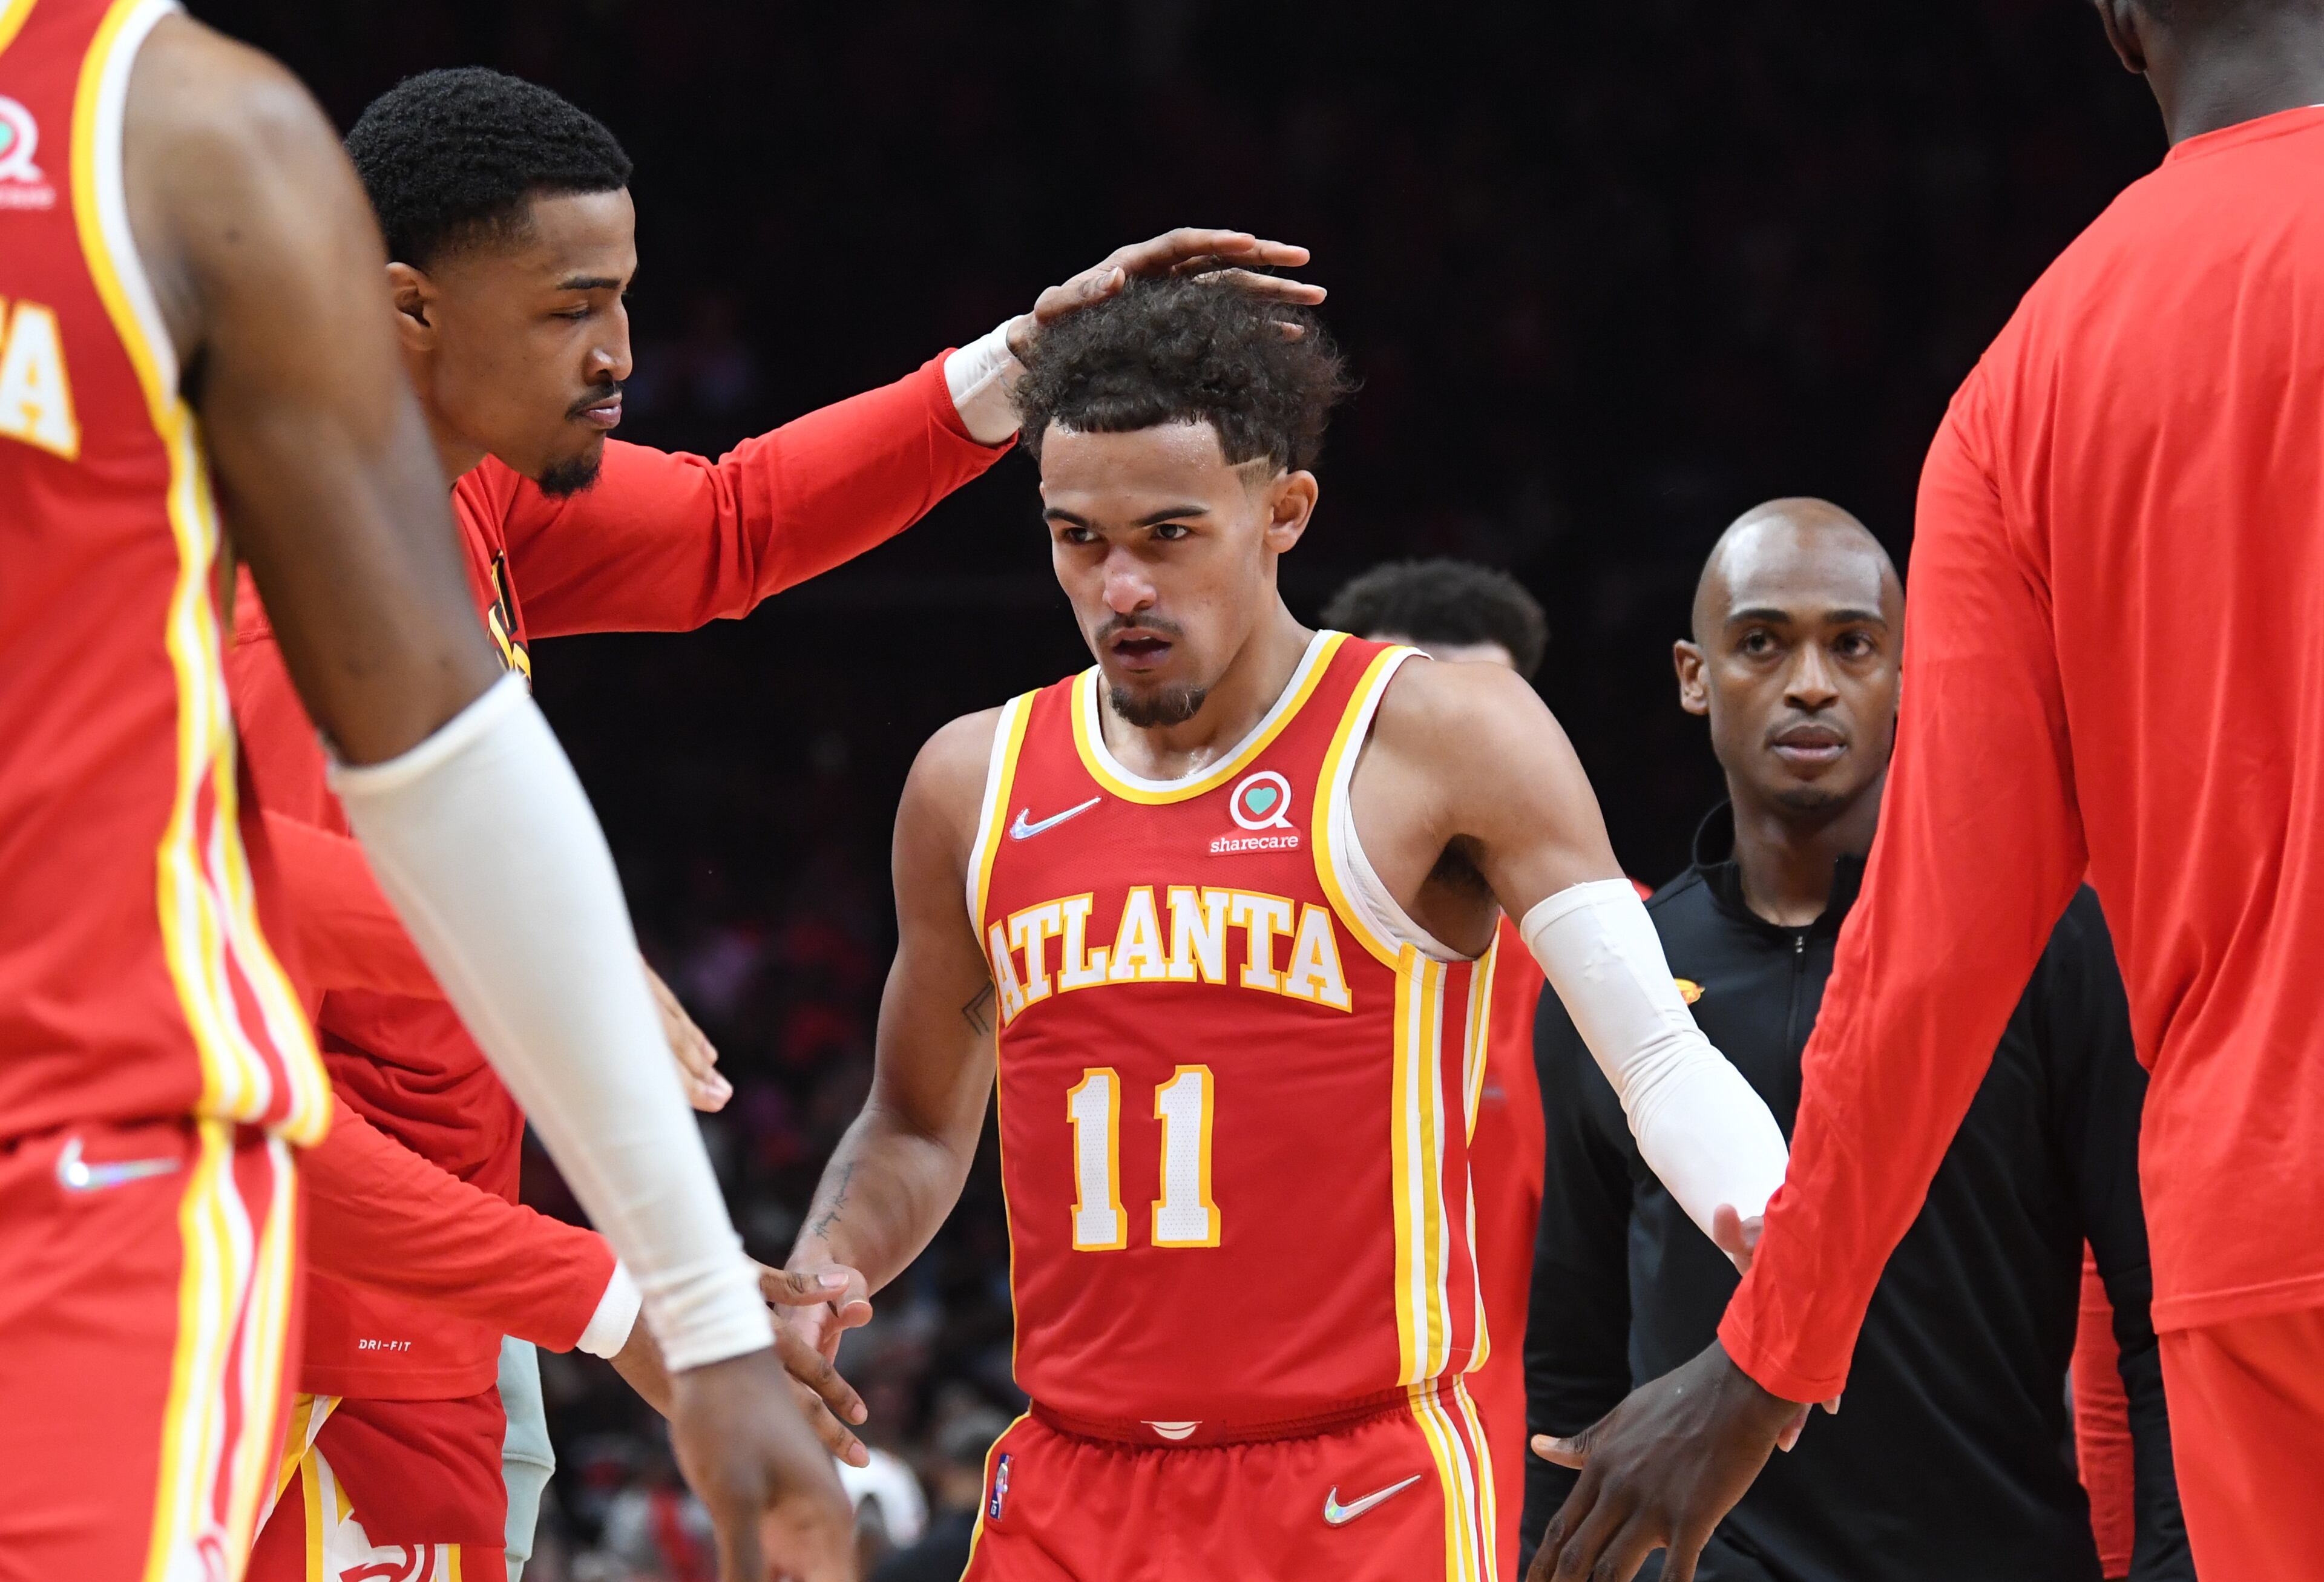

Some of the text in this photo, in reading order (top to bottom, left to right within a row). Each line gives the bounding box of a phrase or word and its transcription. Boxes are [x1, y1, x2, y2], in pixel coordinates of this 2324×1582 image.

[0, 295, 82, 462] A
[1210, 835, 1299, 853] sharecare
[988, 885, 1353, 1028] ATLANTA
[1066, 1064, 1221, 1252] 11
[358, 1339, 411, 1351] DRI-FIT
